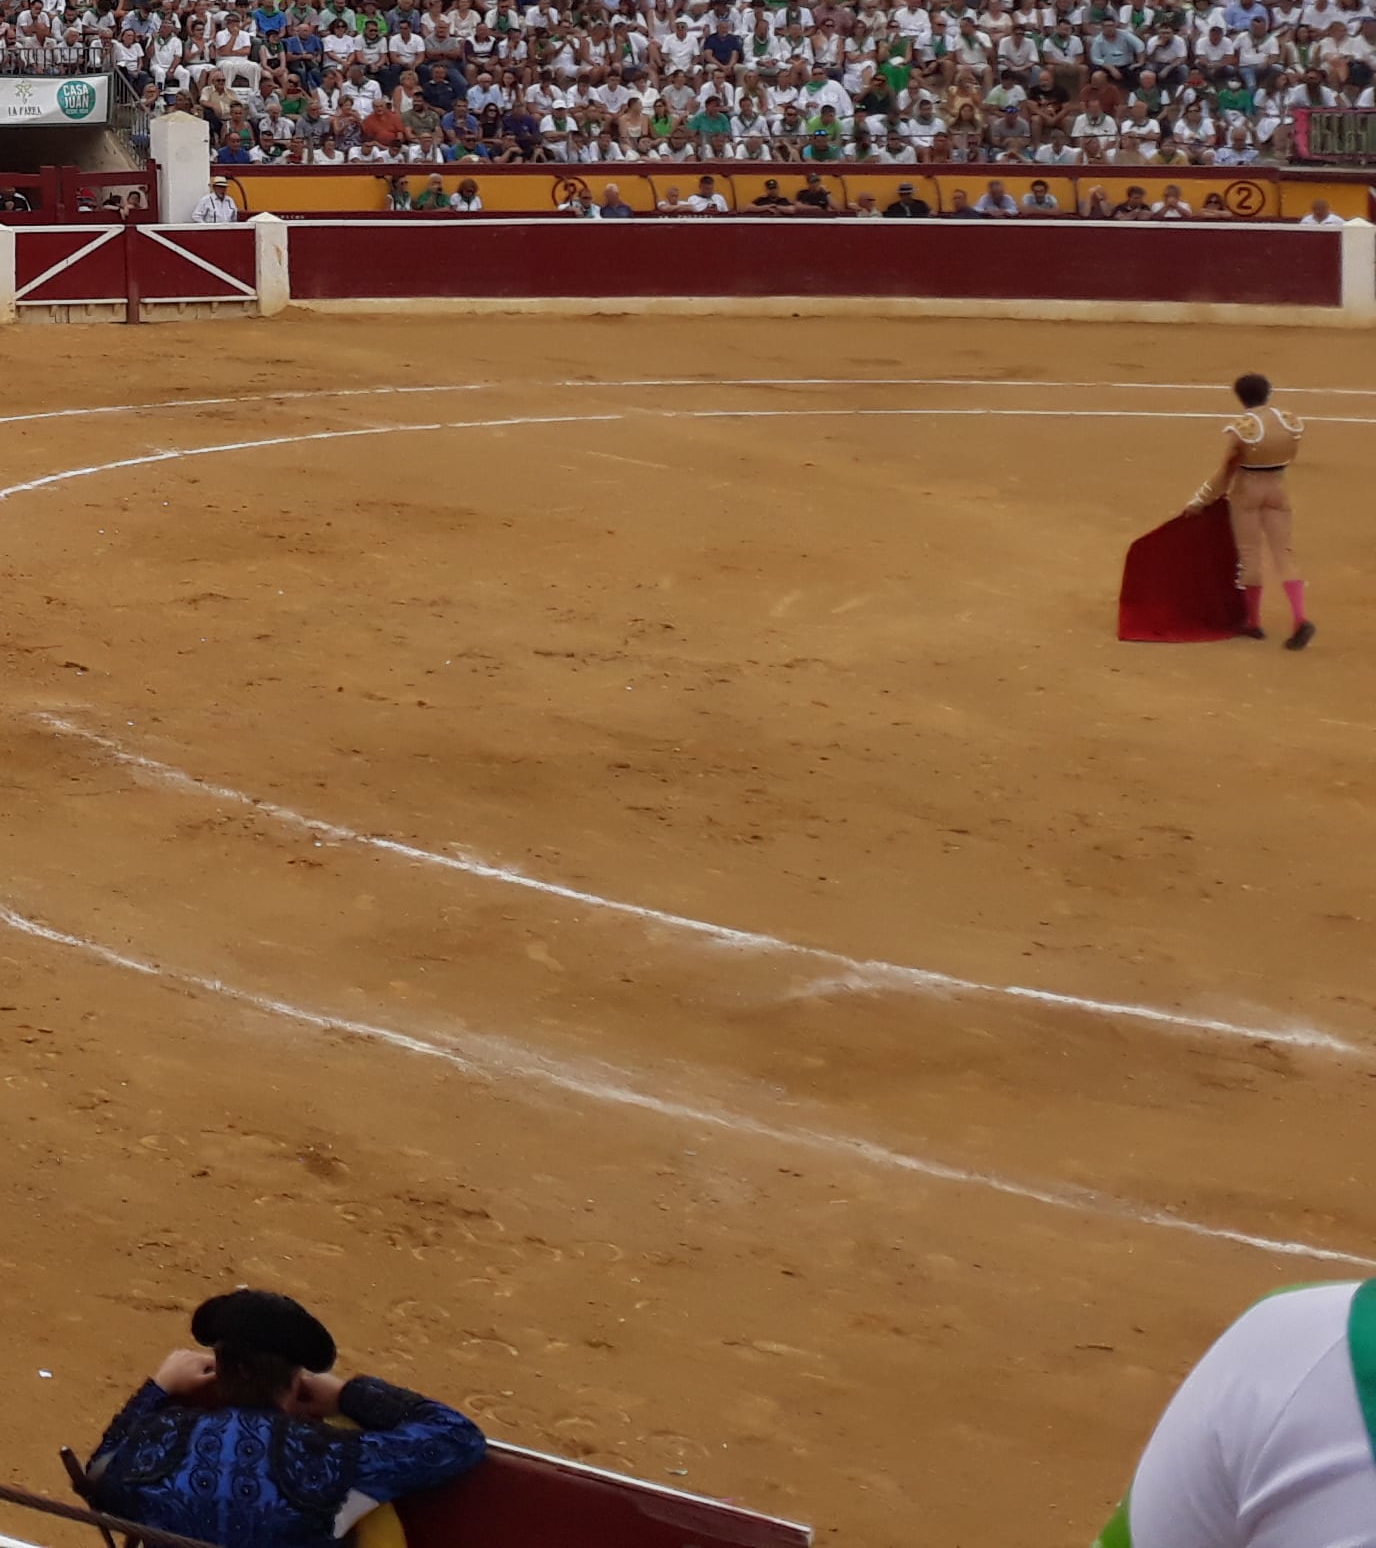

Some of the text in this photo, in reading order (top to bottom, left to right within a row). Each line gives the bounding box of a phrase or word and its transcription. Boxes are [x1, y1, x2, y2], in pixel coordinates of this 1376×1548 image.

[63, 84, 89, 97] CASA
[63, 95, 90, 109] JUAN
[1237, 186, 1253, 210] 2
